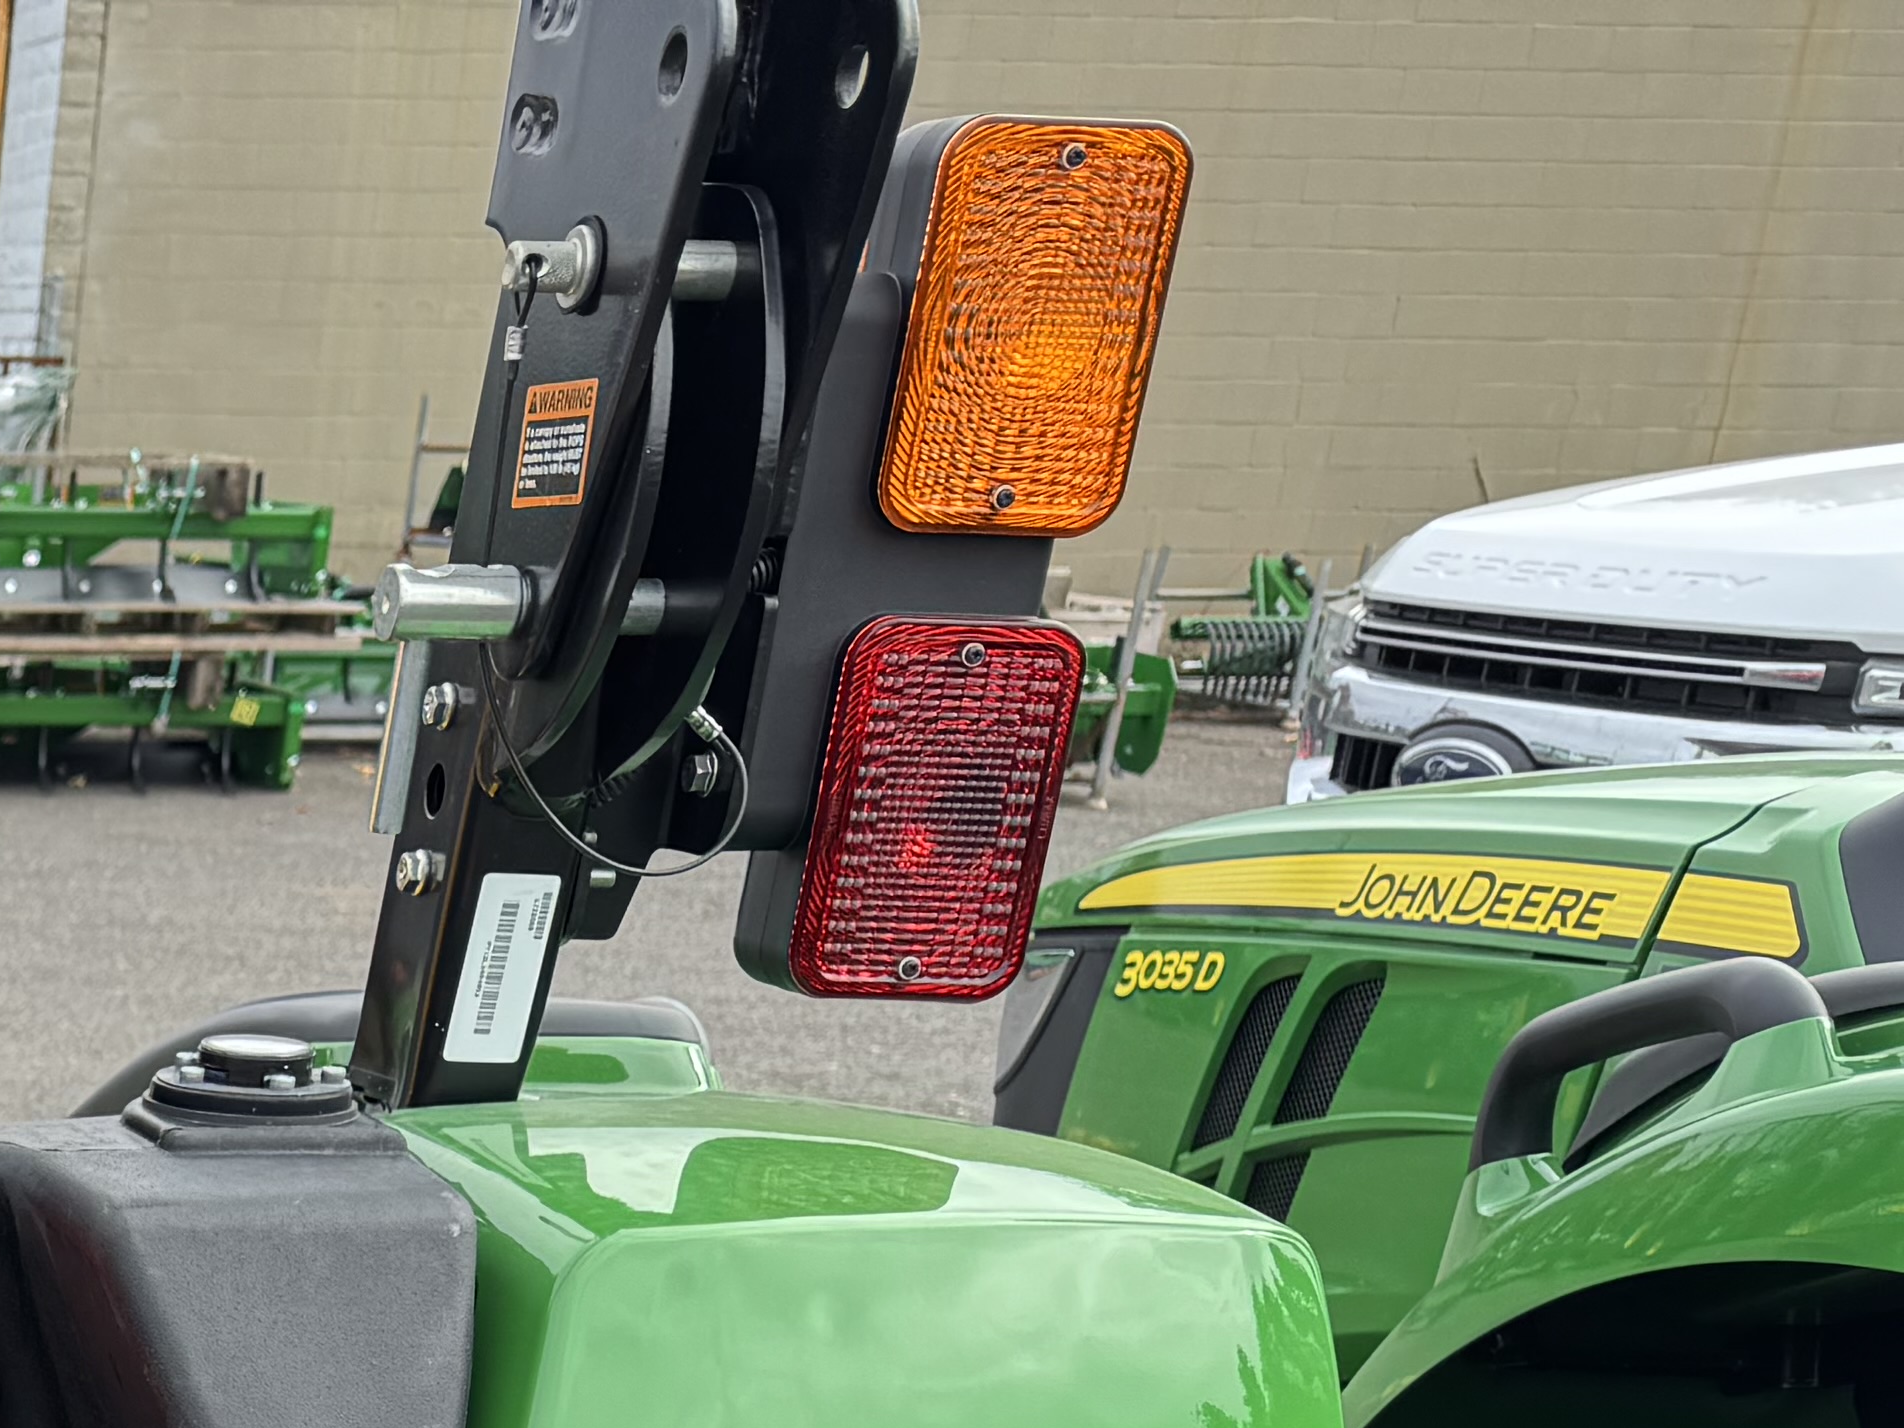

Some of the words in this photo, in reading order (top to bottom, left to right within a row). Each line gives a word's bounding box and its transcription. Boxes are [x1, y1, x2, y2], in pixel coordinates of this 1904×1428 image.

[539, 386, 594, 413] WARNING
[1412, 550, 1579, 590] SUPER
[1585, 564, 1769, 598] DUTY
[1338, 862, 1450, 922] JOHN
[1452, 869, 1618, 934] DEERE
